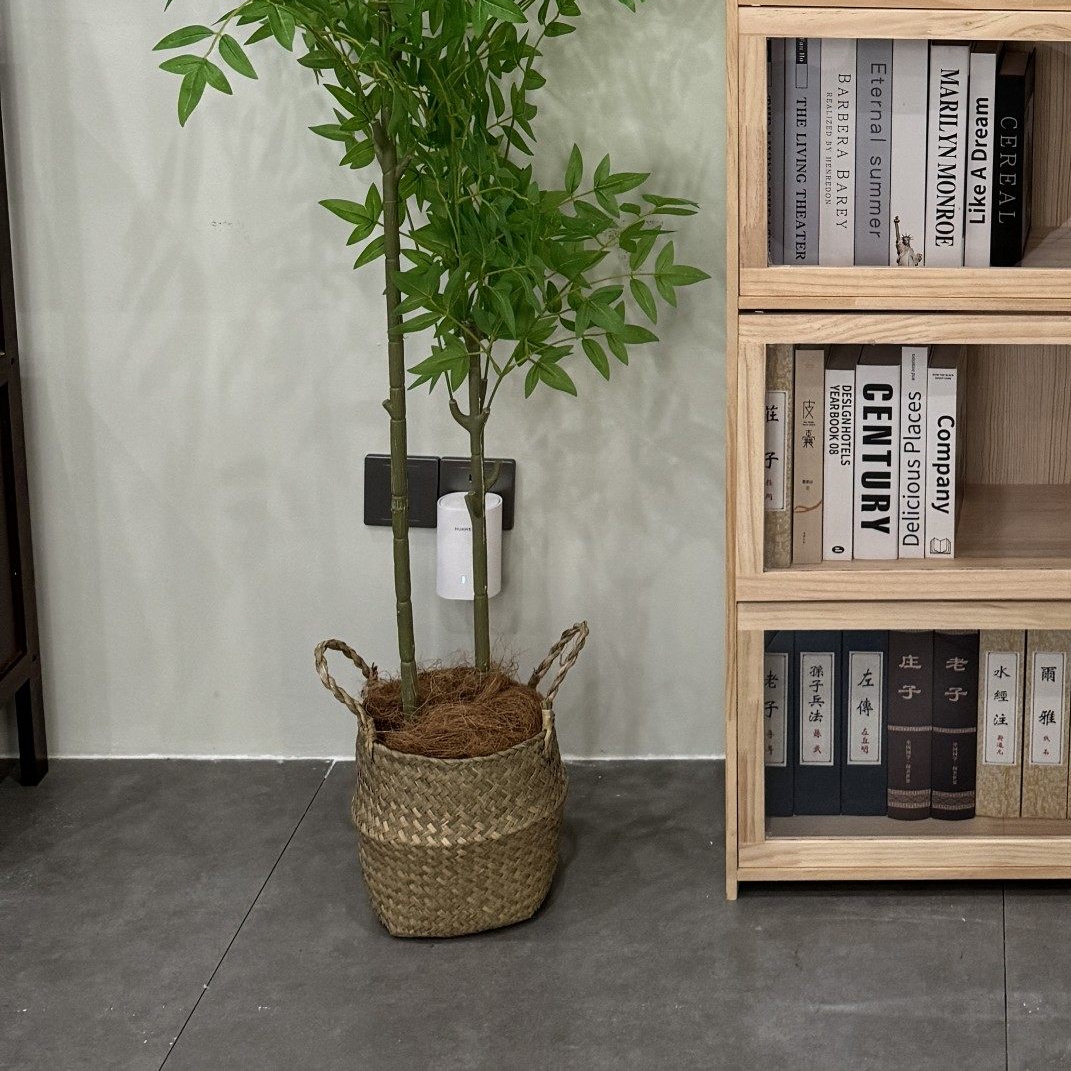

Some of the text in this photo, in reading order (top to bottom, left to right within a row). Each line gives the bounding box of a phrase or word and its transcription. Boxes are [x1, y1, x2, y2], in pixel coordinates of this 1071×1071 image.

[795, 97, 807, 260] THE LIVING THEATER
[824, 92, 833, 205] REALIZED BY HENREDON
[836, 73, 851, 229] BARBERA BAREY
[869, 63, 887, 238] Eternal summer
[935, 68, 960, 247] MARILYN MONROE
[968, 97, 989, 225] Like A Dream
[998, 116, 1018, 224] CEREAL
[829, 442, 839, 455] 08
[860, 383, 894, 534] CENTURY
[901, 391, 922, 547] Delicious Places
[931, 415, 955, 514] Company
[808, 665, 825, 723] 孫子兵法
[857, 668, 874, 717] 左傳
[898, 654, 922, 700] 庄子
[944, 657, 968, 702] 老子
[993, 665, 1011, 726] 水經注
[1038, 666, 1058, 727] 爾雅
